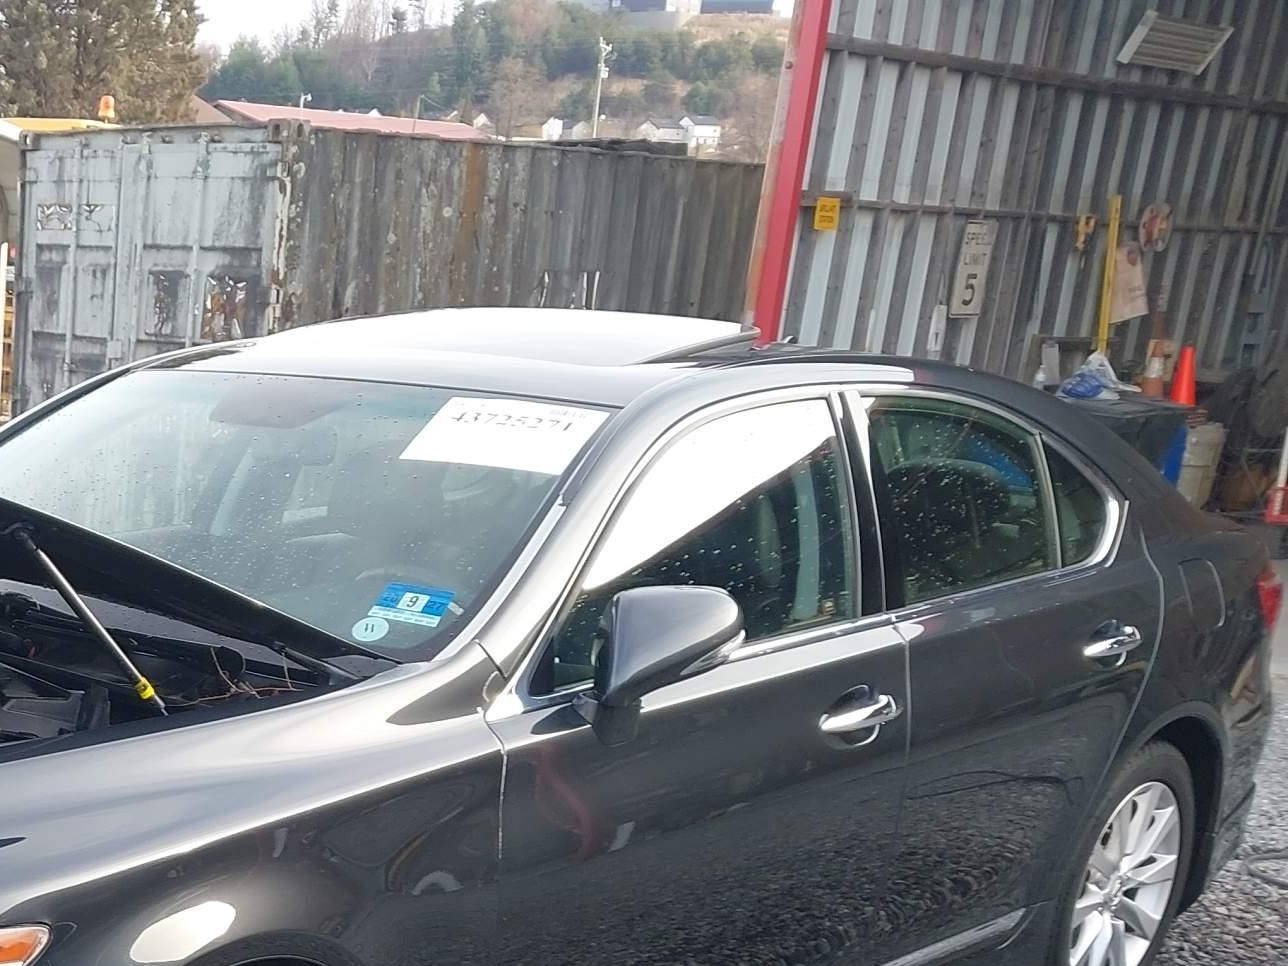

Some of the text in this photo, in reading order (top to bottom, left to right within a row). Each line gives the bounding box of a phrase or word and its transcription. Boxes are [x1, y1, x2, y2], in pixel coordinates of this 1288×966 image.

[961, 273, 978, 306] 5
[450, 411, 573, 431] 43725271
[406, 595, 420, 608] 9
